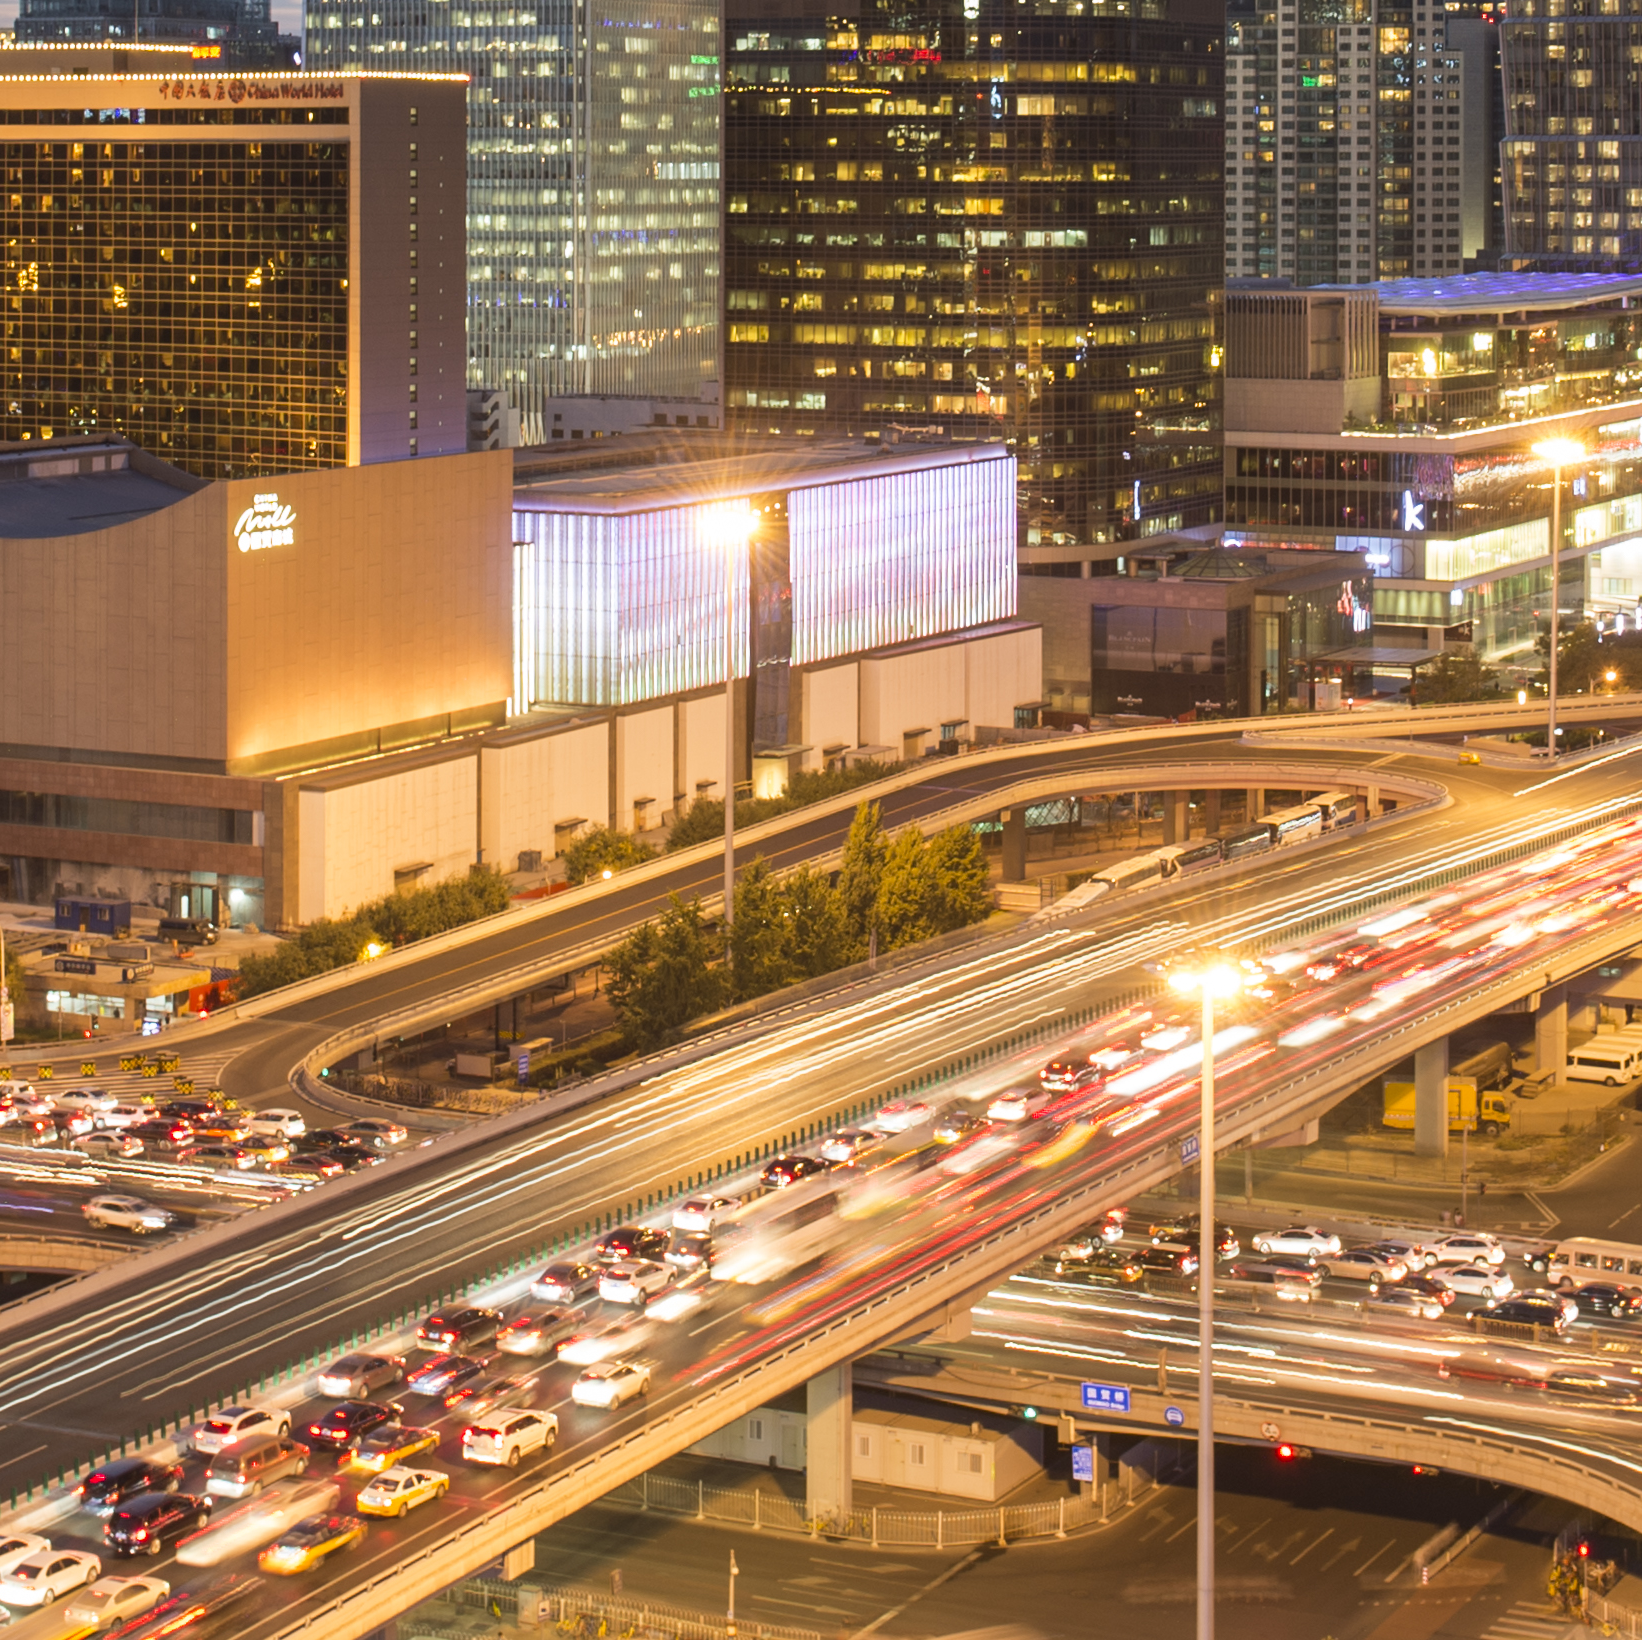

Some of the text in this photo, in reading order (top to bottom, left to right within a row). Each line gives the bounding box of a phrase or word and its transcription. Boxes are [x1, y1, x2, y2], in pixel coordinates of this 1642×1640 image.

[247, 81, 280, 101] China
[280, 82, 314, 100] World
[314, 82, 344, 100] Hotel
